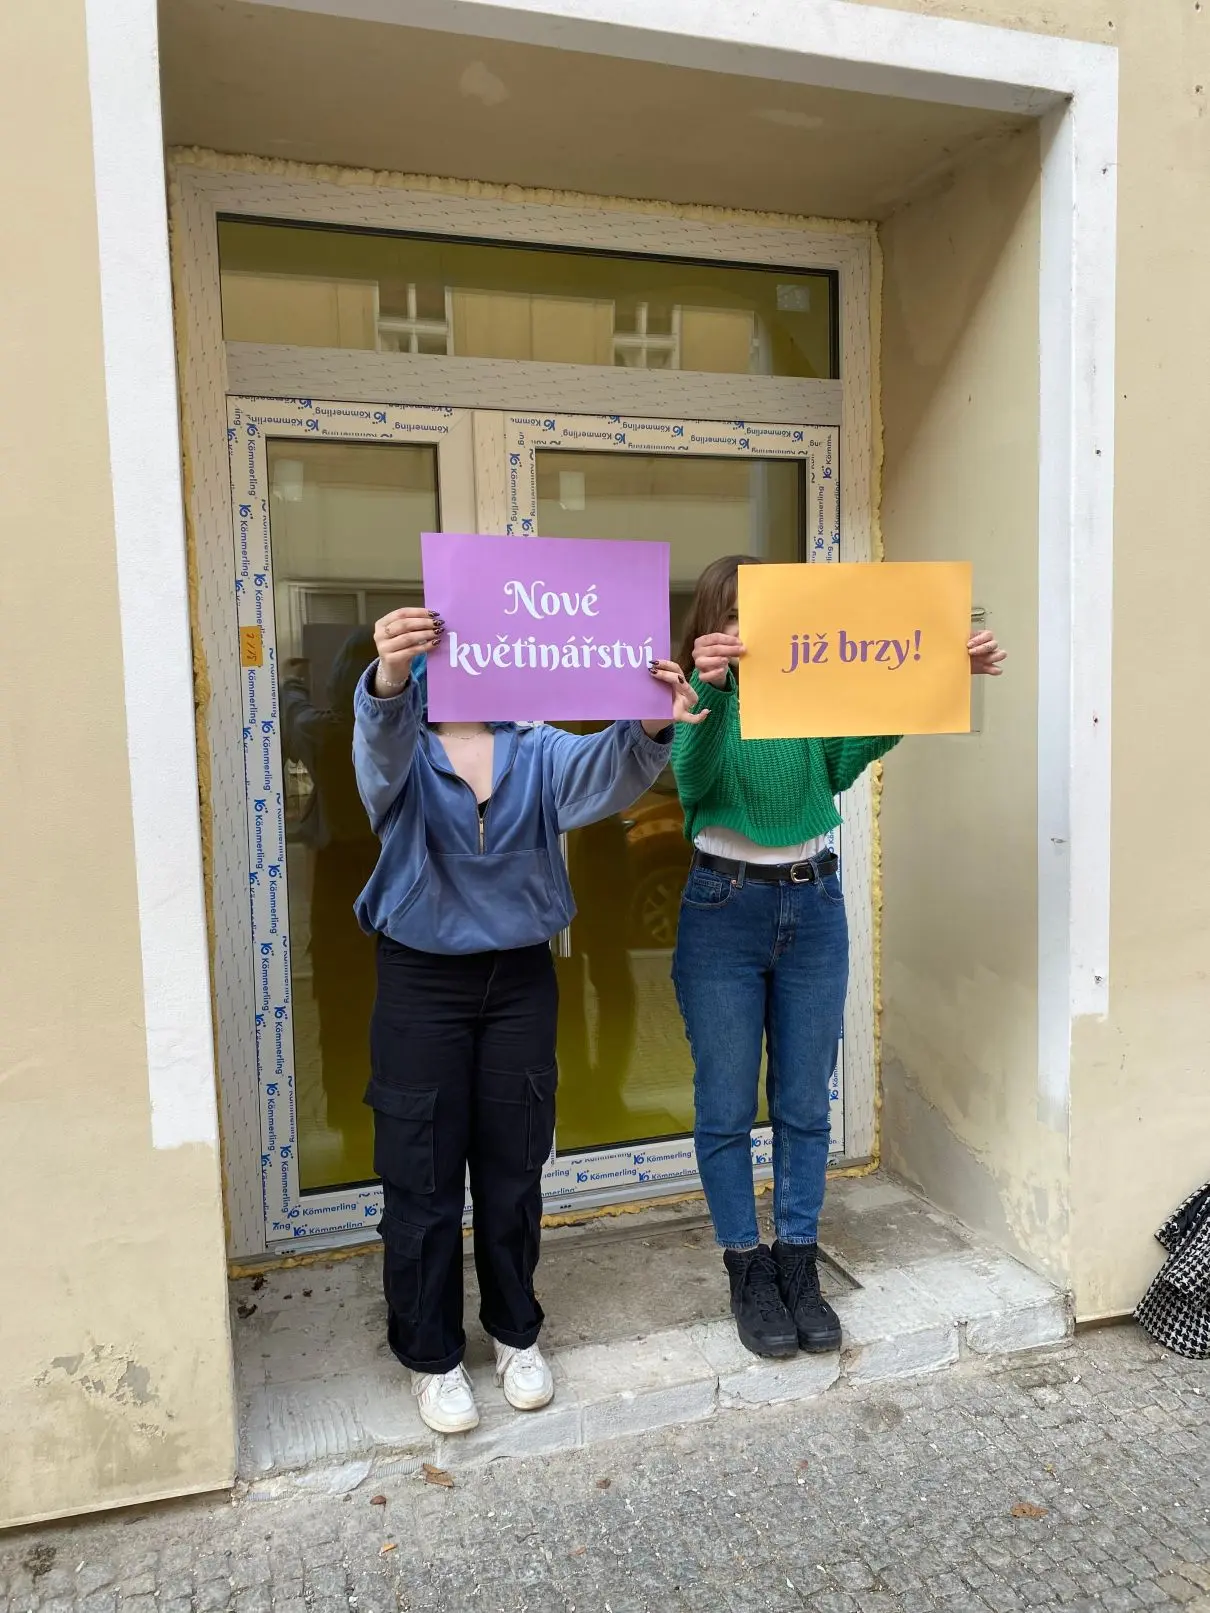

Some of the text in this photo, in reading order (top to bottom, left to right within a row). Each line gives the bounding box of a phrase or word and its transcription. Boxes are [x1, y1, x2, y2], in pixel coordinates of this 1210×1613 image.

[503, 580, 600, 620] Nové
[447, 632, 653, 676] květinářství
[781, 630, 922, 674] již brzy!
[302, 1202, 358, 1217] Kömmerling
